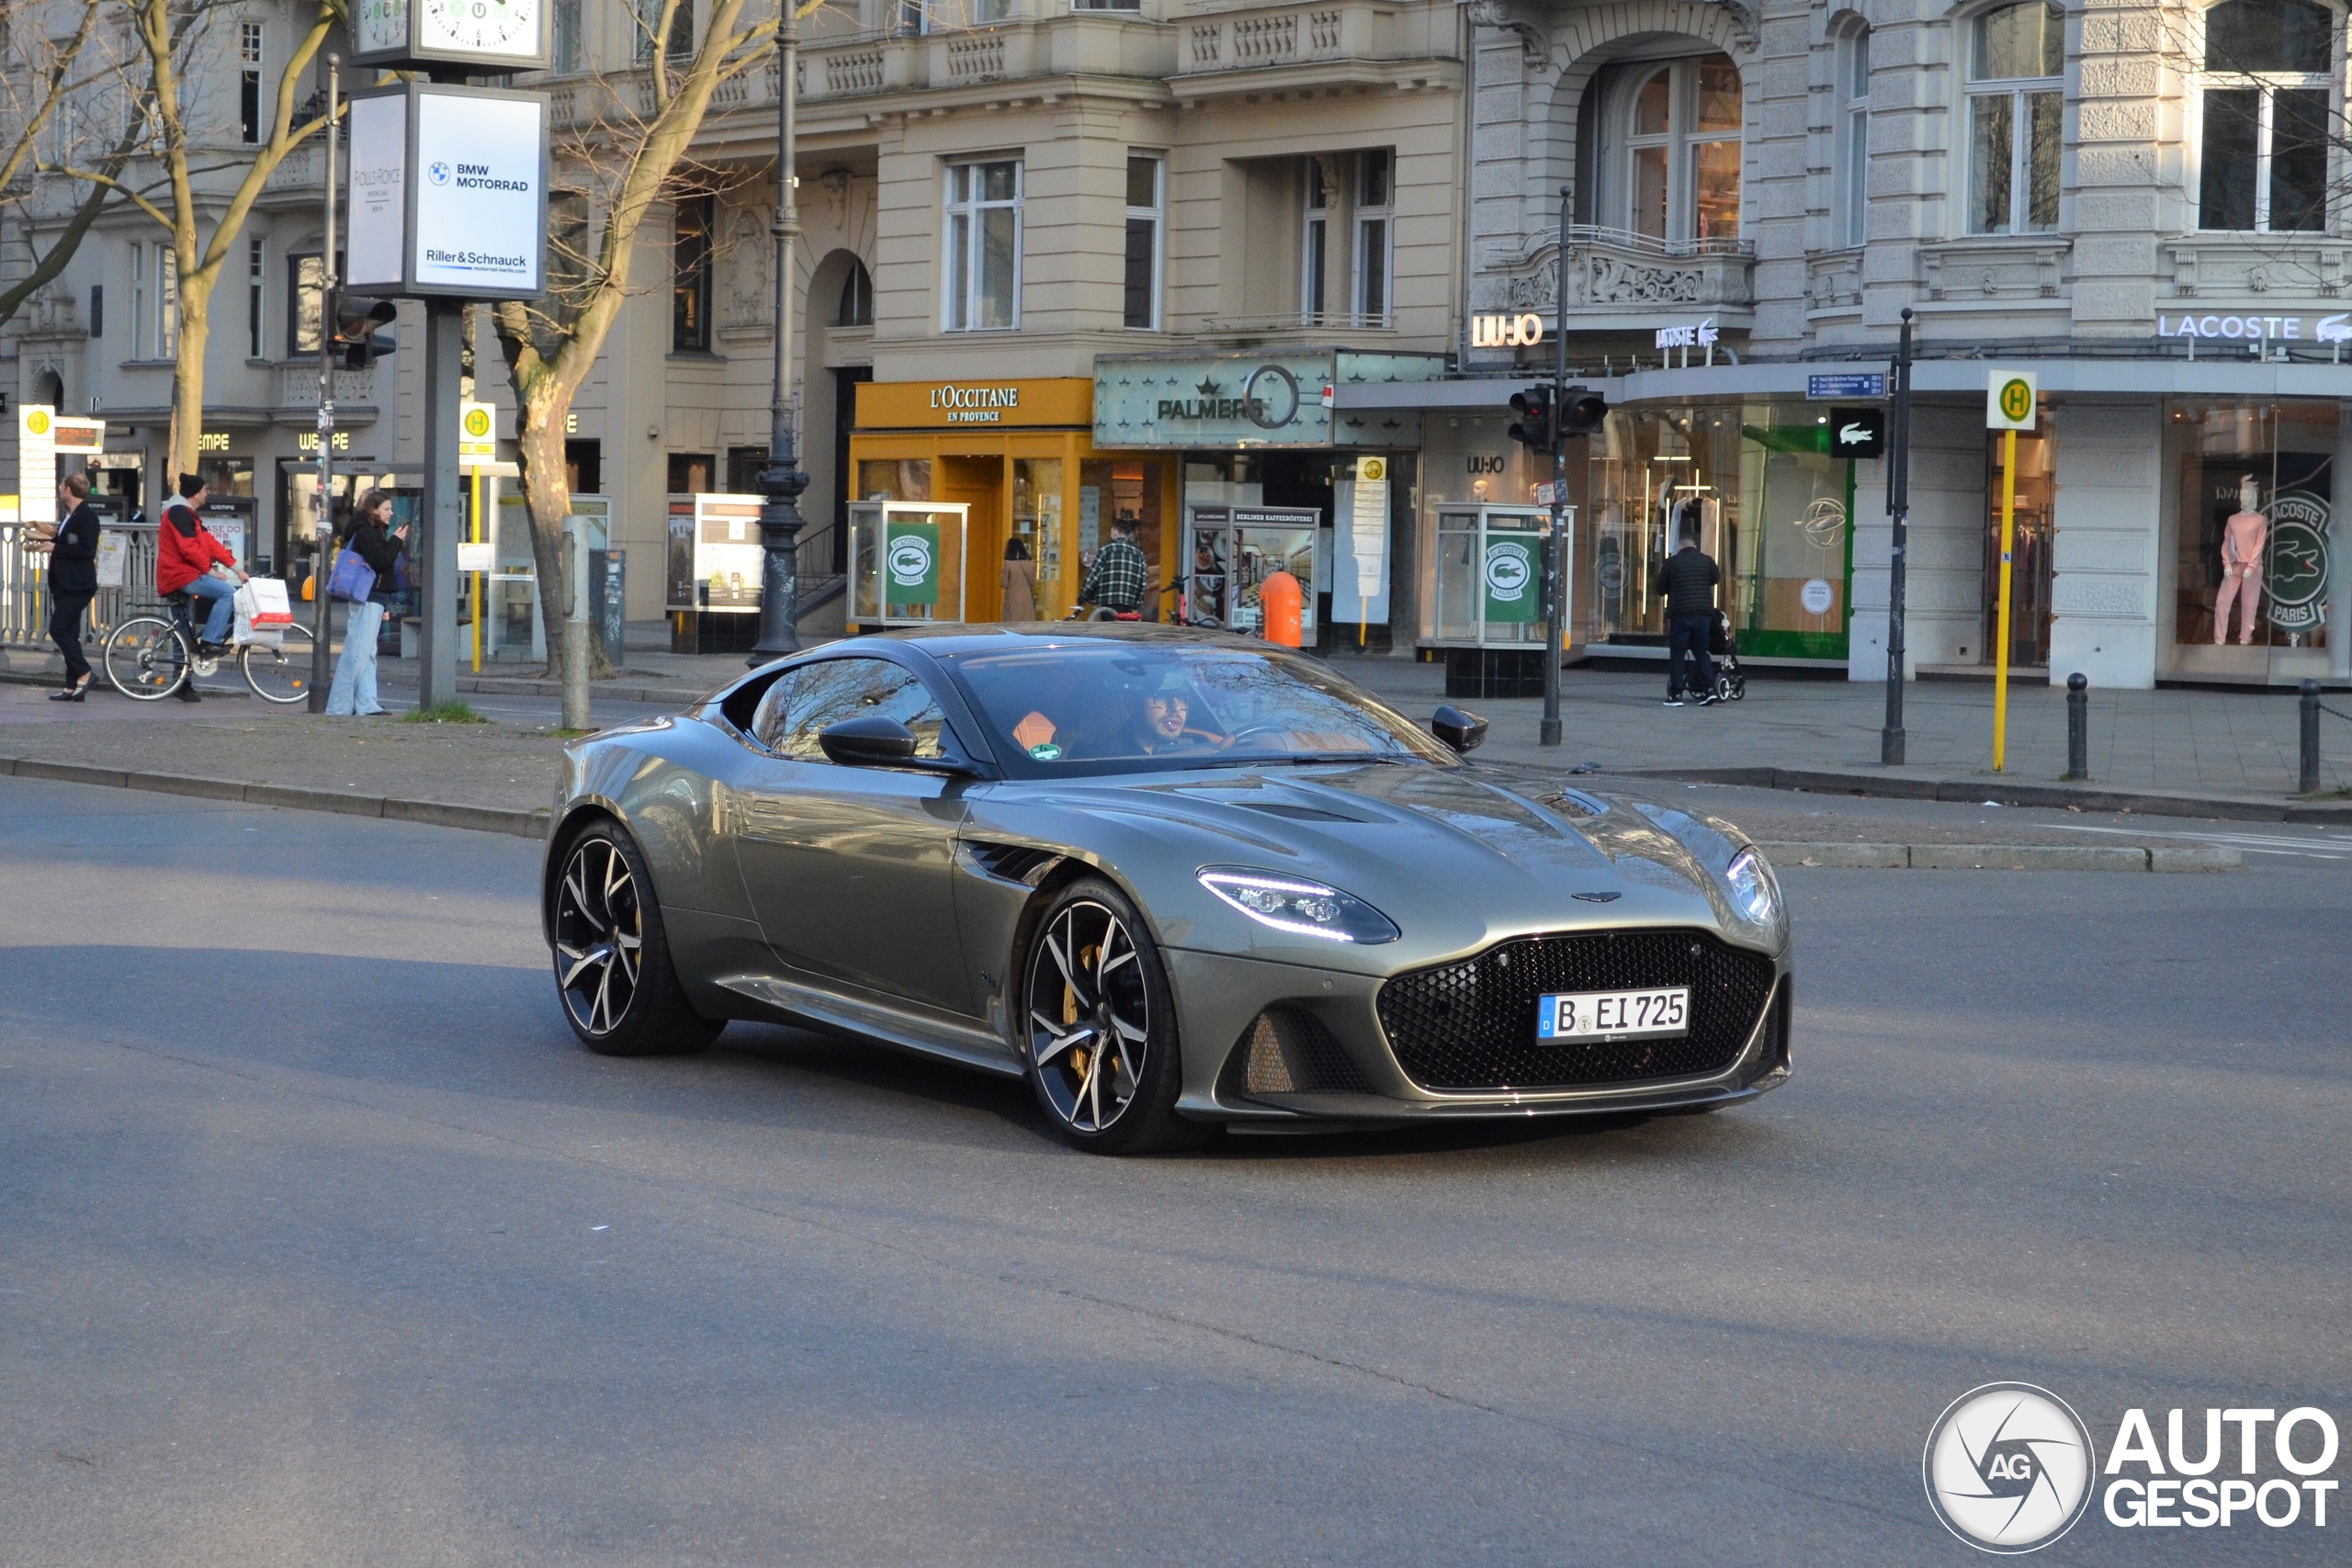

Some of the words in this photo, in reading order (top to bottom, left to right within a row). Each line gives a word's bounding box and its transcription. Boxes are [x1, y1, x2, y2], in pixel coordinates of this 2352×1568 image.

[354, 168, 401, 186] ROLLS-ROYCE
[457, 164, 490, 175] BMW
[456, 177, 528, 192] MOTORRAD
[2159, 315, 2301, 339] LACOSTE
[1656, 325, 1696, 349] LACOSTE
[947, 412, 958, 422] EN
[959, 411, 1000, 422] PROVENCE
[1157, 397, 1263, 420] PALMERS
[198, 433, 230, 451] EMPE
[299, 432, 349, 451] WEPE
[2274, 502, 2319, 526] ACOSTE
[207, 525, 224, 533] ASE
[1492, 547, 1522, 558] LACOSTE
[2274, 604, 2309, 622] PARIS
[1543, 1021, 1551, 1031] D
[1557, 1000, 1577, 1032] B
[1635, 993, 1685, 1027] 725
